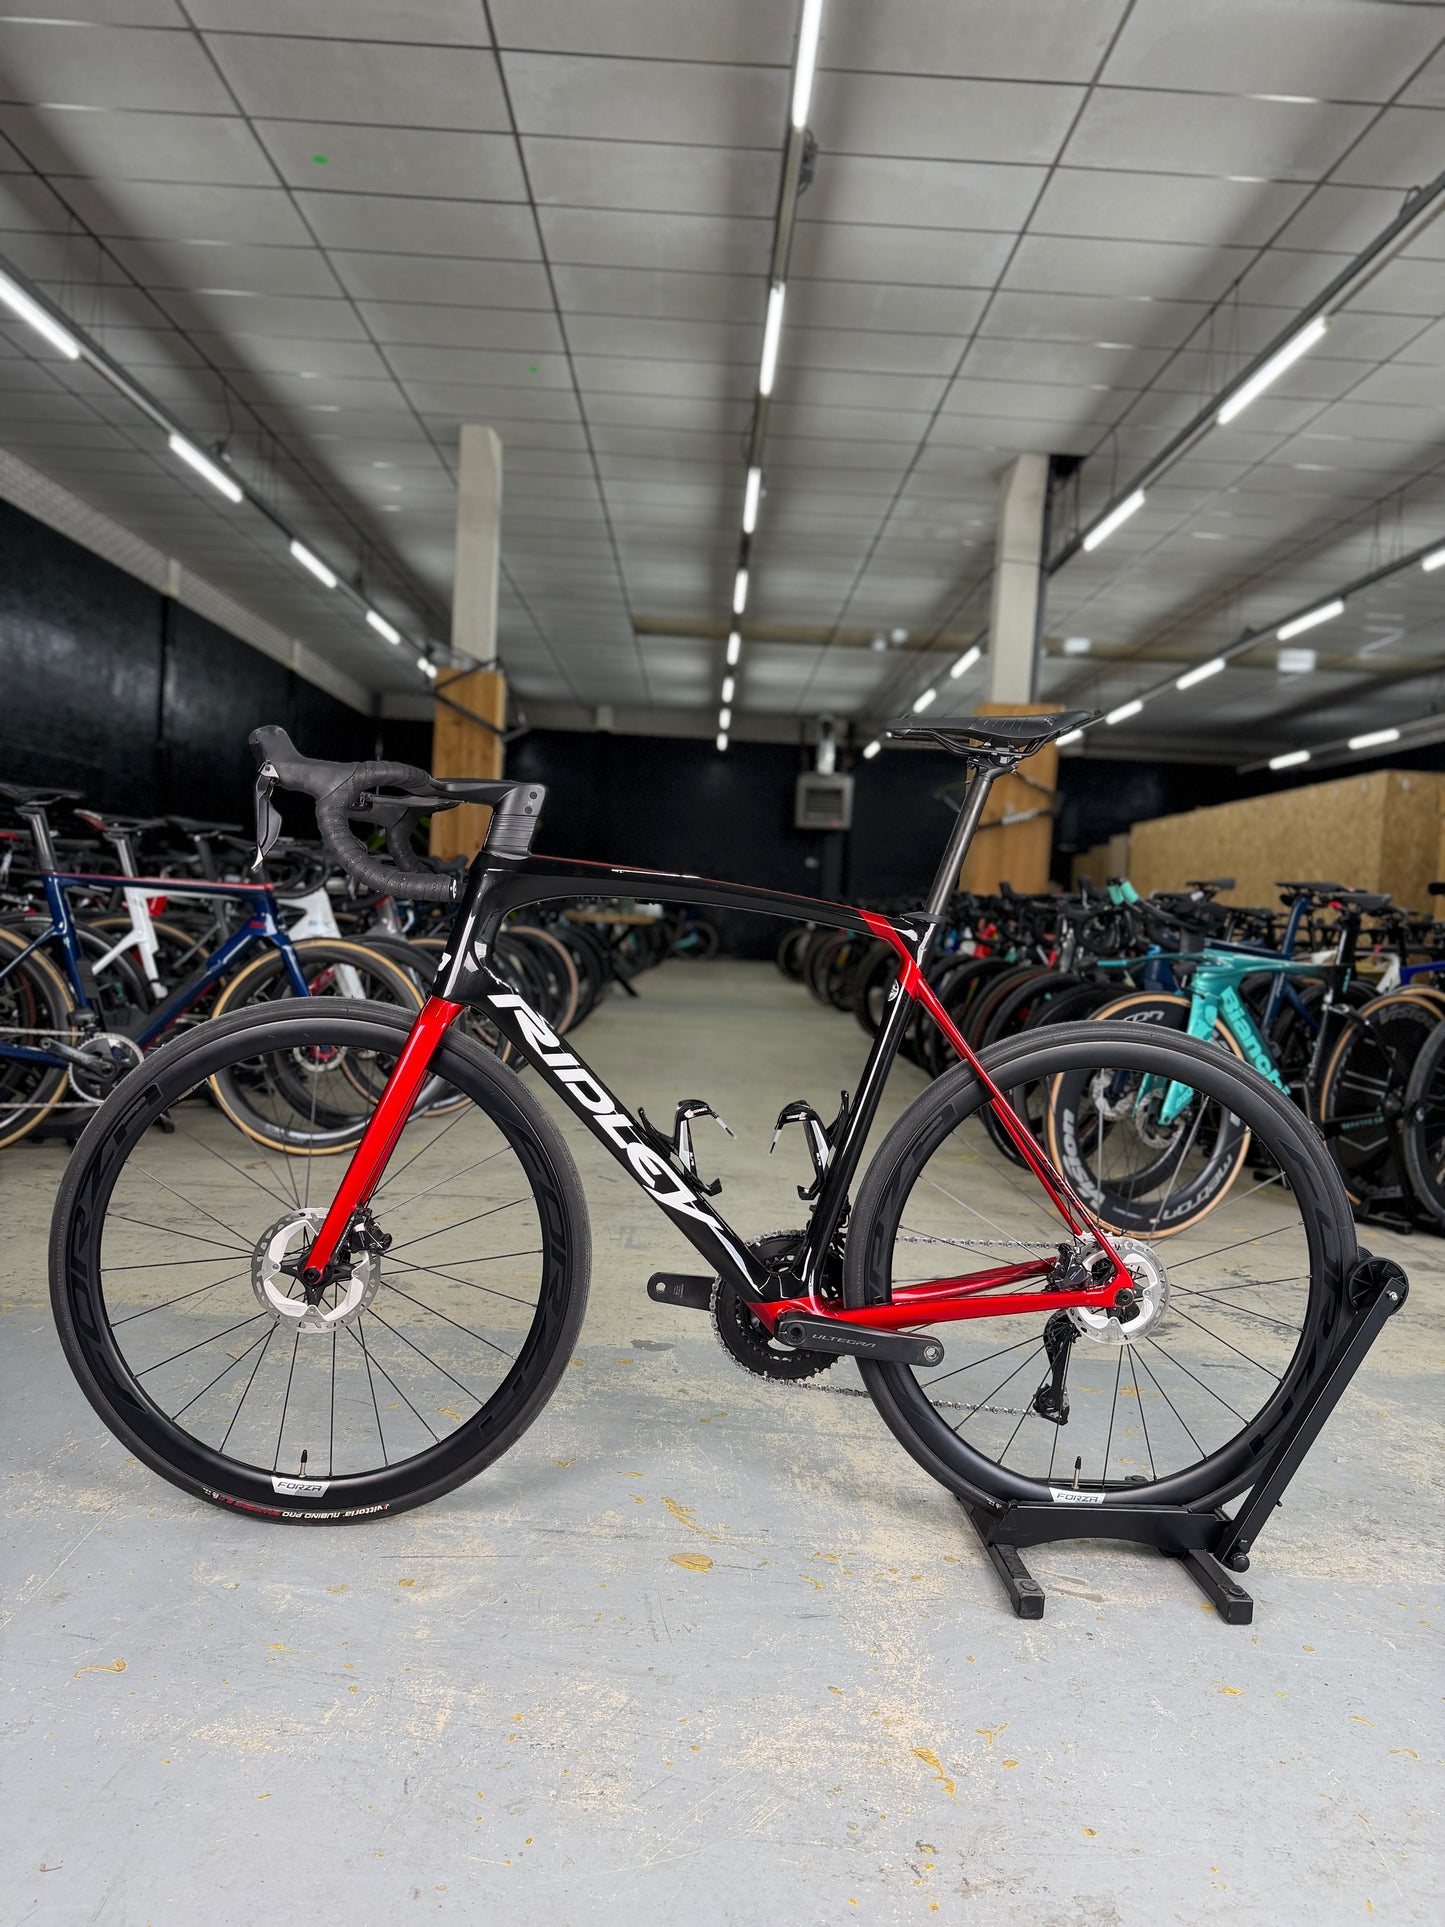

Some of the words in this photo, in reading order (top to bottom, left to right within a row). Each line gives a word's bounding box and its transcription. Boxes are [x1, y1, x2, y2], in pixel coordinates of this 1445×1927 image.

[487, 994, 725, 1231] RIDLEY
[811, 1333, 877, 1349] ULTEGRA
[277, 1481, 323, 1492] FORZA
[1056, 1492, 1099, 1503] FORZA
[281, 1511, 302, 1519] PRO
[344, 1504, 383, 1517] vittoria
